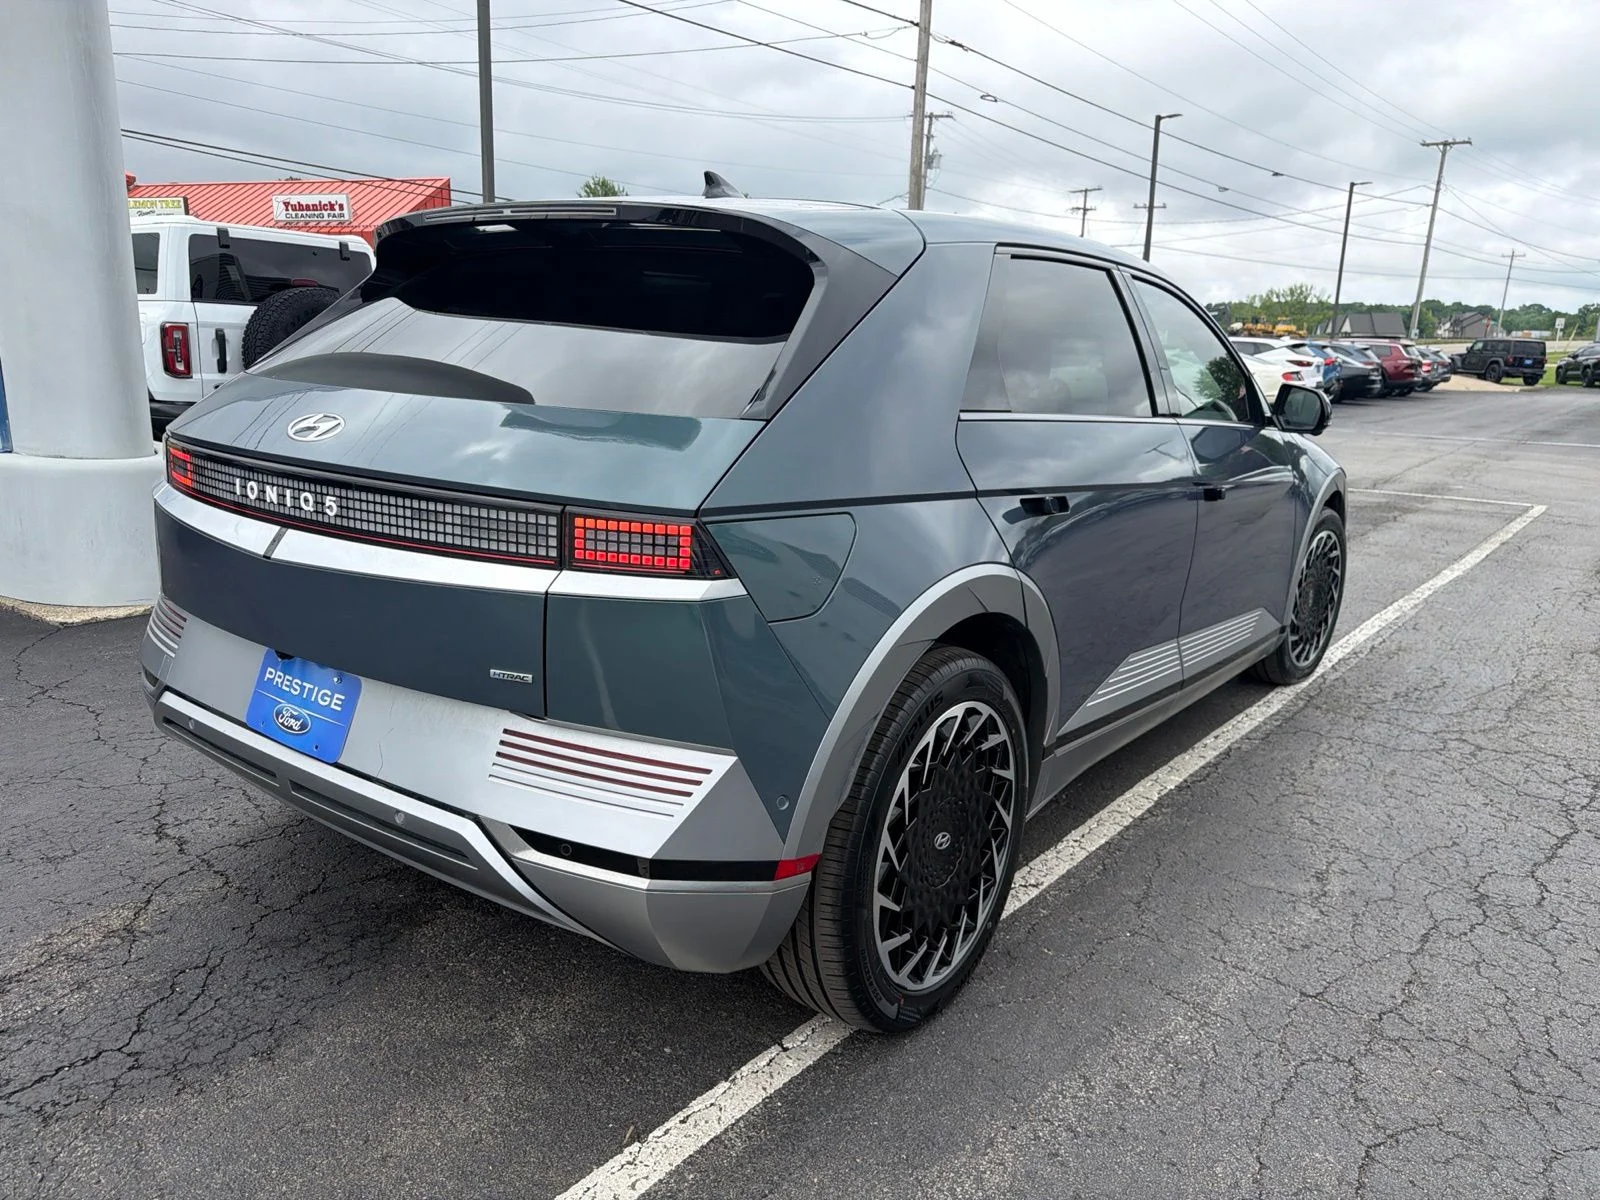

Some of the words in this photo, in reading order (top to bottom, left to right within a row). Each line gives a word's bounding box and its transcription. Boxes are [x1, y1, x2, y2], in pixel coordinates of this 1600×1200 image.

[158, 200, 182, 208] TREE
[283, 200, 344, 212] Yuhanick's
[236, 478, 314, 512] IONIQ
[325, 496, 338, 517] 5
[492, 671, 530, 682] HTRAC
[264, 667, 346, 711] PRESTIGE
[278, 706, 304, 731] Ford
